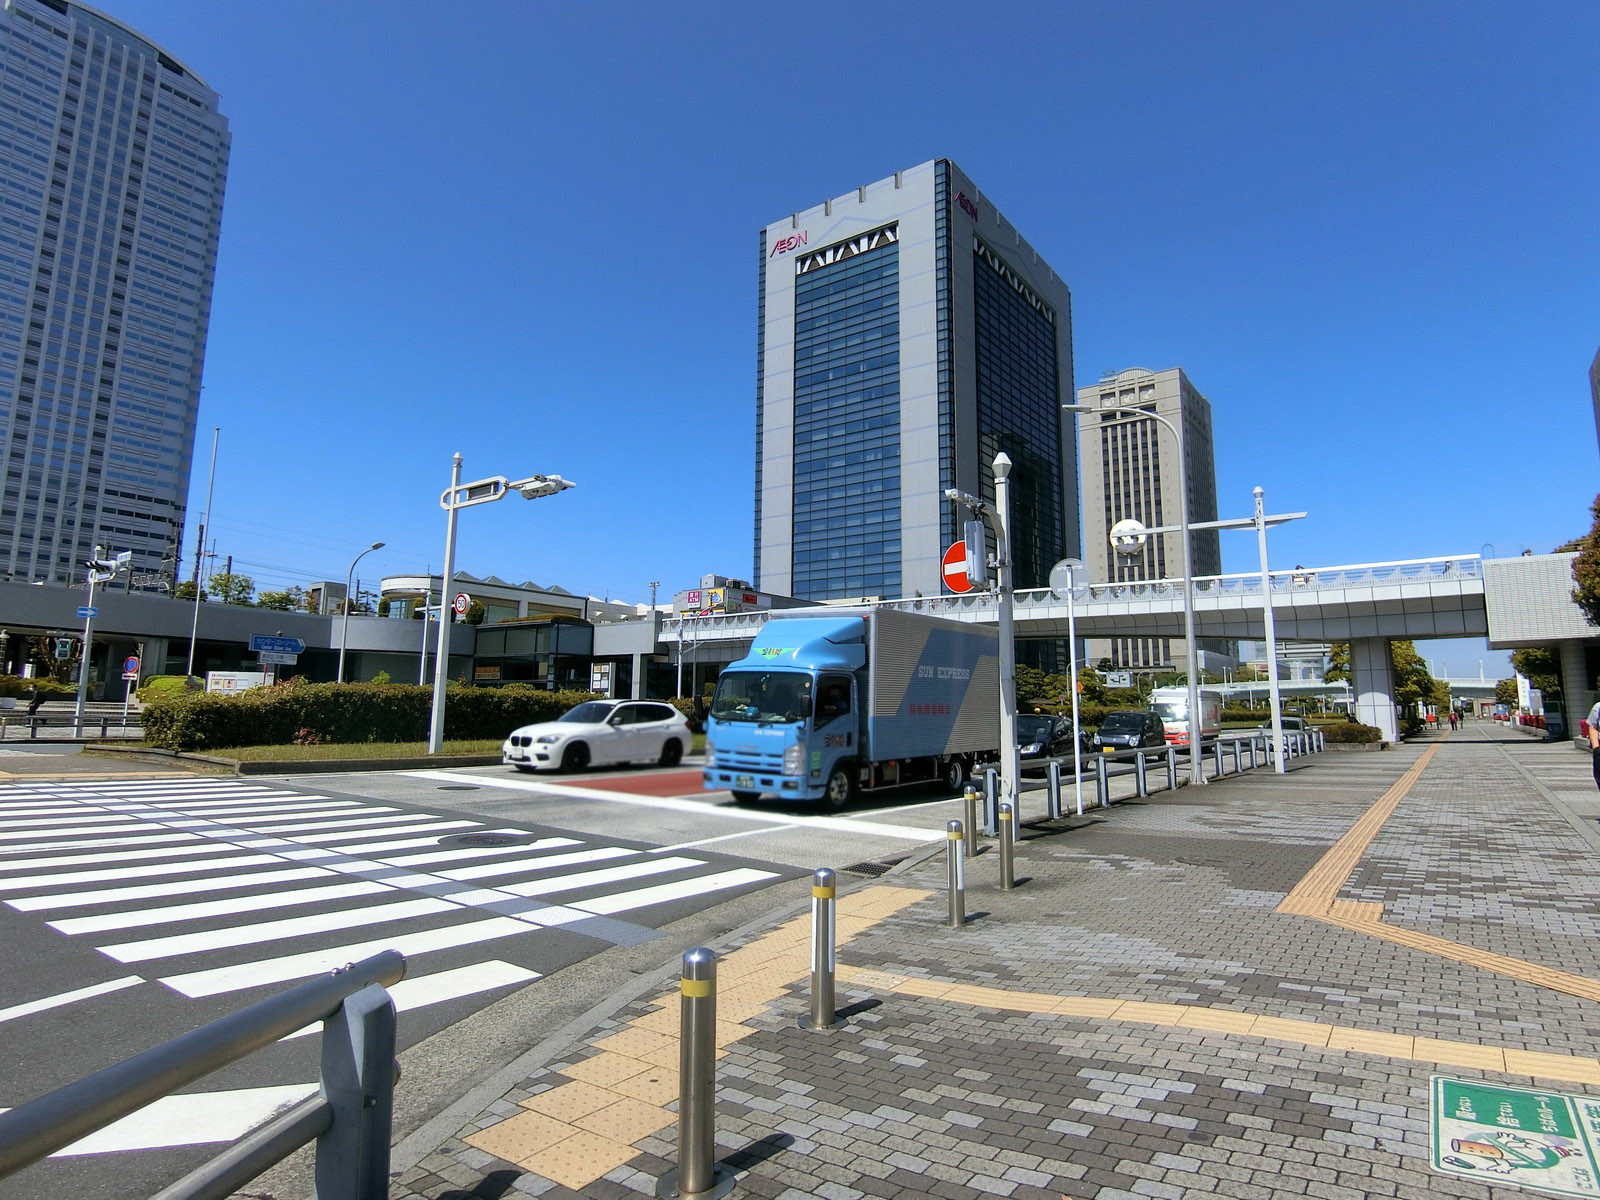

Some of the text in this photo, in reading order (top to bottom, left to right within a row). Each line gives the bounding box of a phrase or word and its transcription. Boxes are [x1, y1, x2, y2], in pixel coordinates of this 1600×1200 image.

[458, 600, 465, 608] 50
[257, 638, 296, 646] センターストリート
[761, 647, 783, 656] SUN
[918, 665, 970, 680] SUN EXPRESS
[1496, 1101, 1521, 1128] 捨てない
